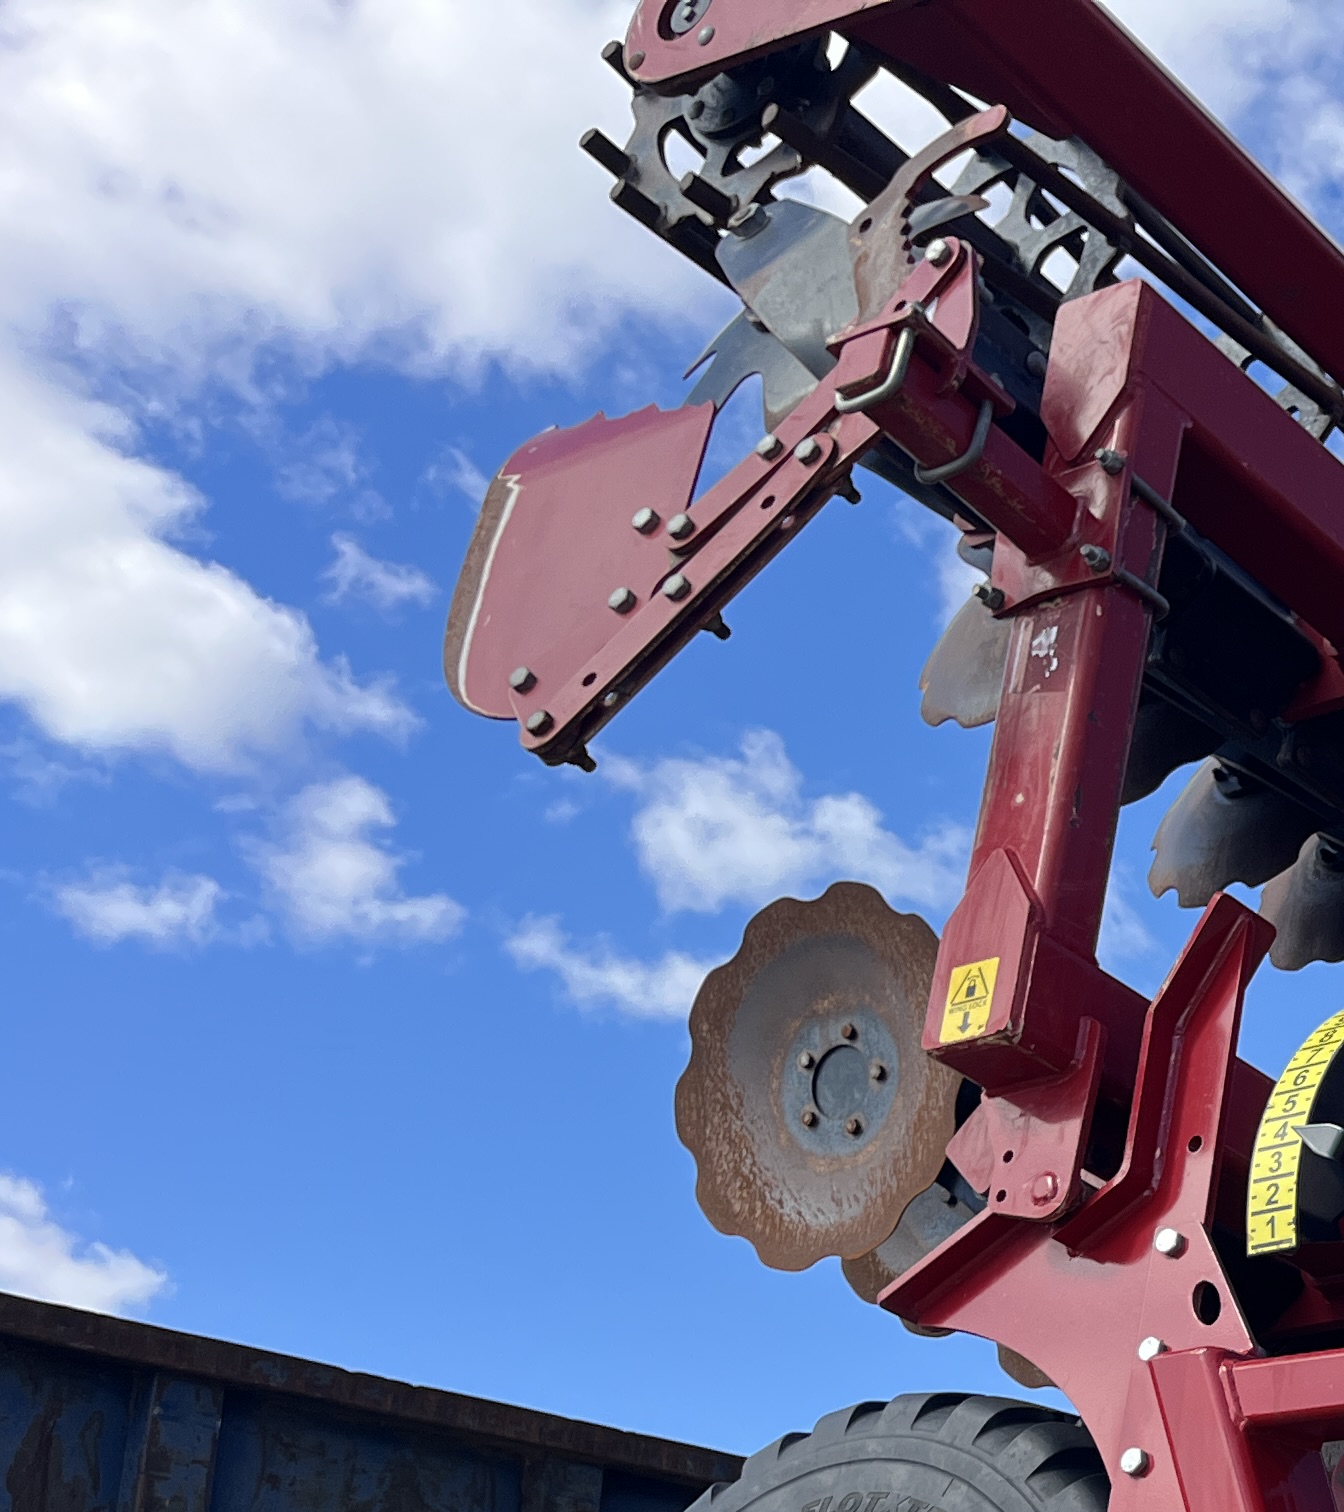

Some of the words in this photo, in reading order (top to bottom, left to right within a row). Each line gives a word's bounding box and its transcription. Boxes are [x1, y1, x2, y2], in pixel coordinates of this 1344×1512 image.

[1318, 1029, 1337, 1043] 8
[1306, 1048, 1323, 1064] 7
[1293, 1069, 1306, 1087] 6
[1281, 1094, 1299, 1113] 5
[1273, 1121, 1289, 1141] 4
[1268, 1151, 1283, 1173] 3
[1265, 1183, 1279, 1206] 2
[1265, 1215, 1276, 1239] 1
